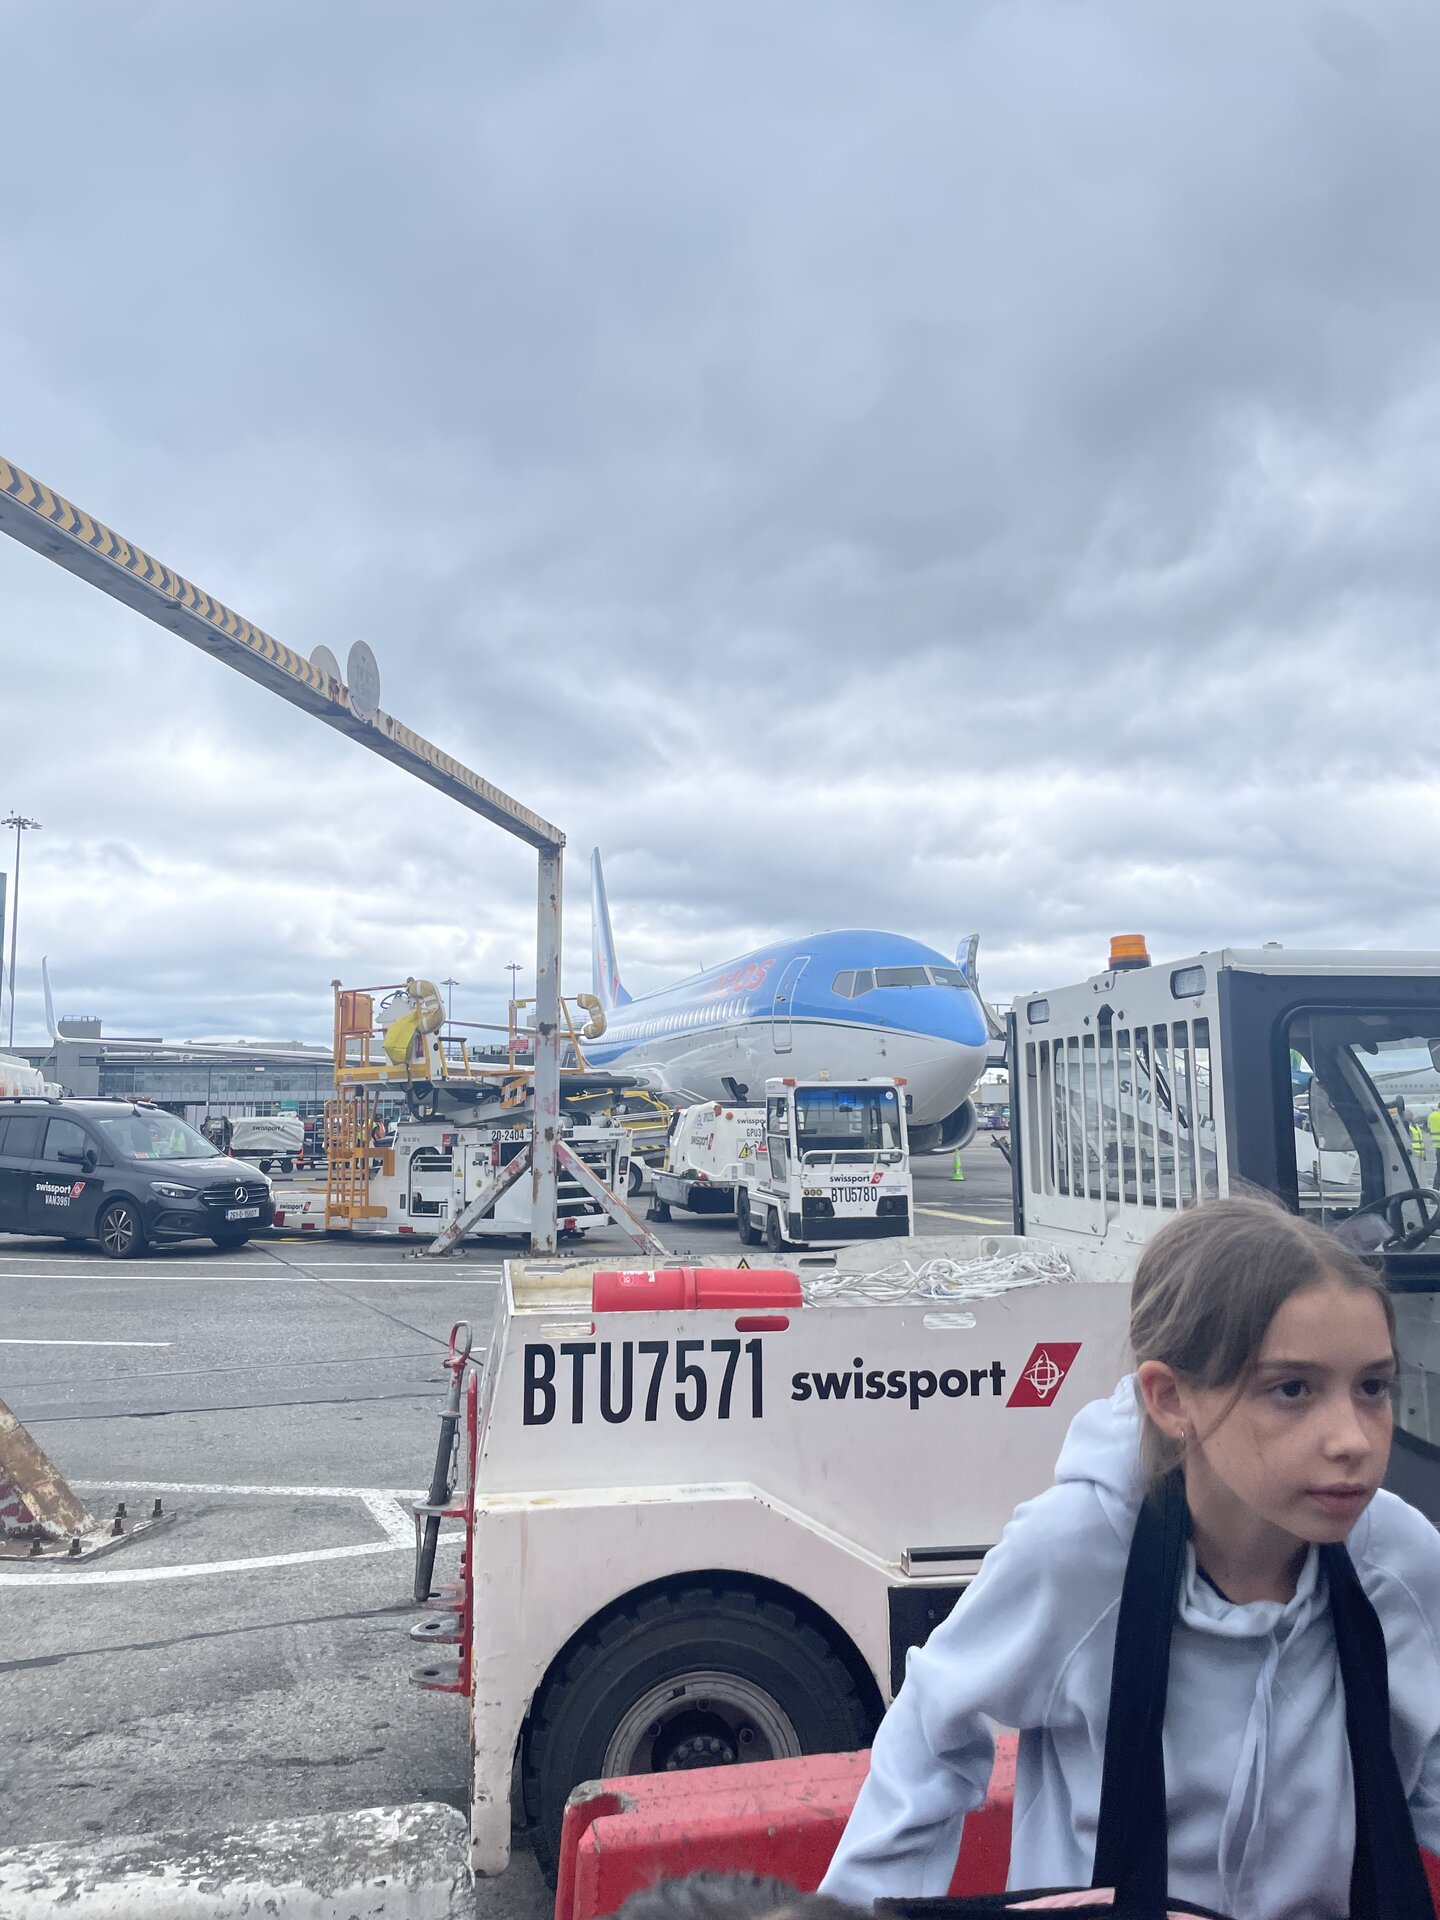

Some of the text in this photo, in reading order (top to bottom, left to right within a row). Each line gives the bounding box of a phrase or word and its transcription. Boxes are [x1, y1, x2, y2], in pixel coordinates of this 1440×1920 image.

[252, 1124, 280, 1132] swissport
[491, 1130, 524, 1141] 20-2404
[830, 1174, 870, 1184] swissport
[35, 1181, 71, 1195] swissport
[45, 1195, 70, 1206] VAN3961
[831, 1187, 877, 1202] BTU5780
[523, 1338, 763, 1426] BTU7571
[791, 1357, 1006, 1410] swissport
